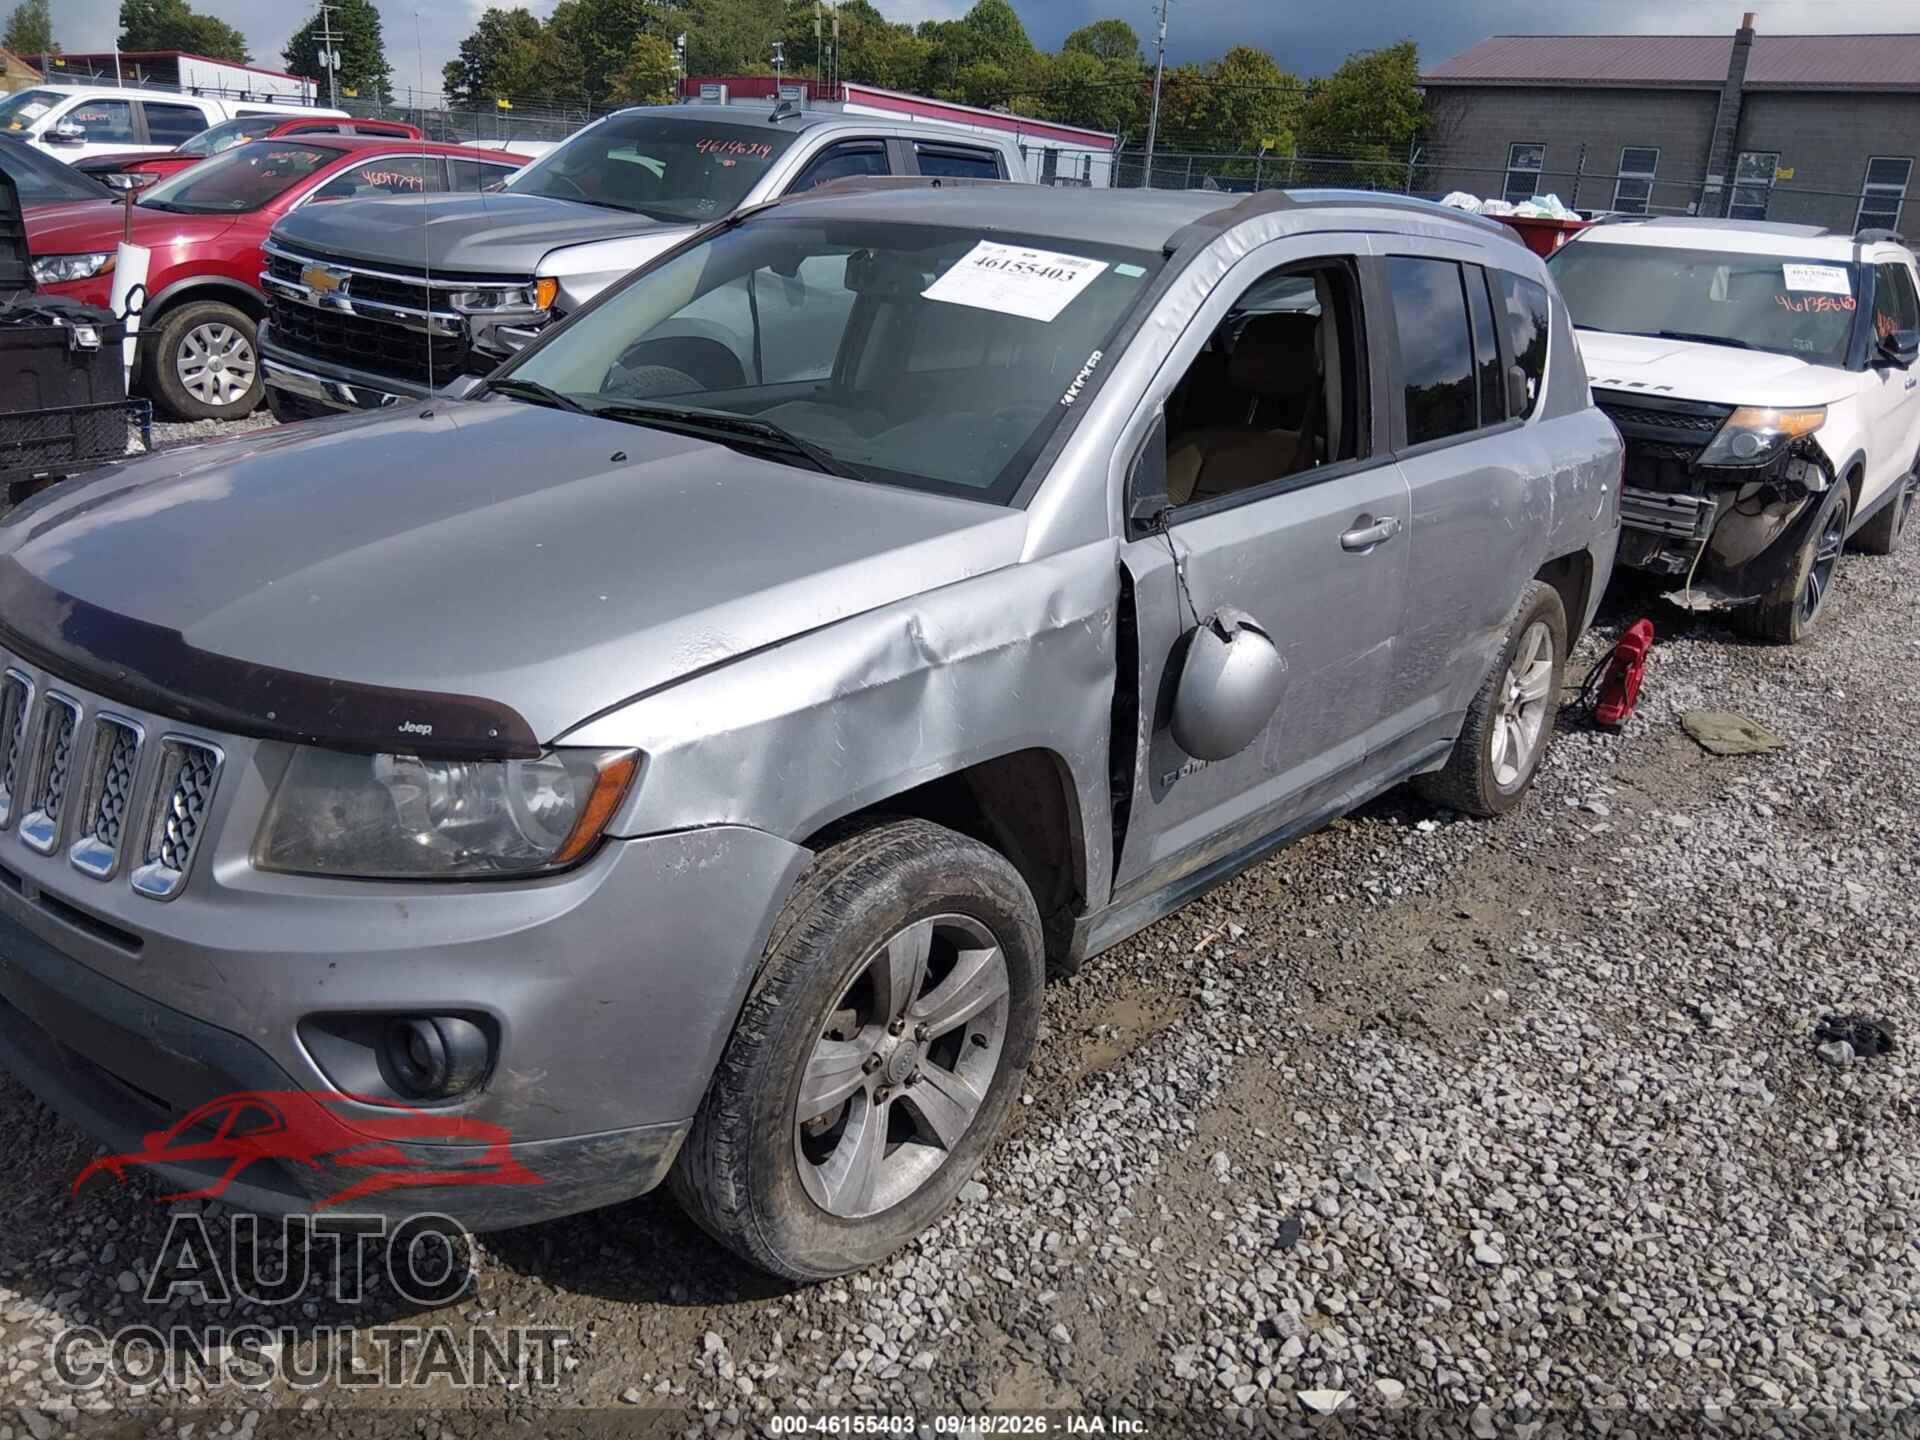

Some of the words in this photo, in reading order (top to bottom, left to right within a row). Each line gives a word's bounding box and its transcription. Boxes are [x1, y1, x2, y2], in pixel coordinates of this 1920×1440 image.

[973, 256, 1077, 282] 46155403
[1066, 350, 1104, 397] KICKER
[398, 720, 433, 736] Jeep
